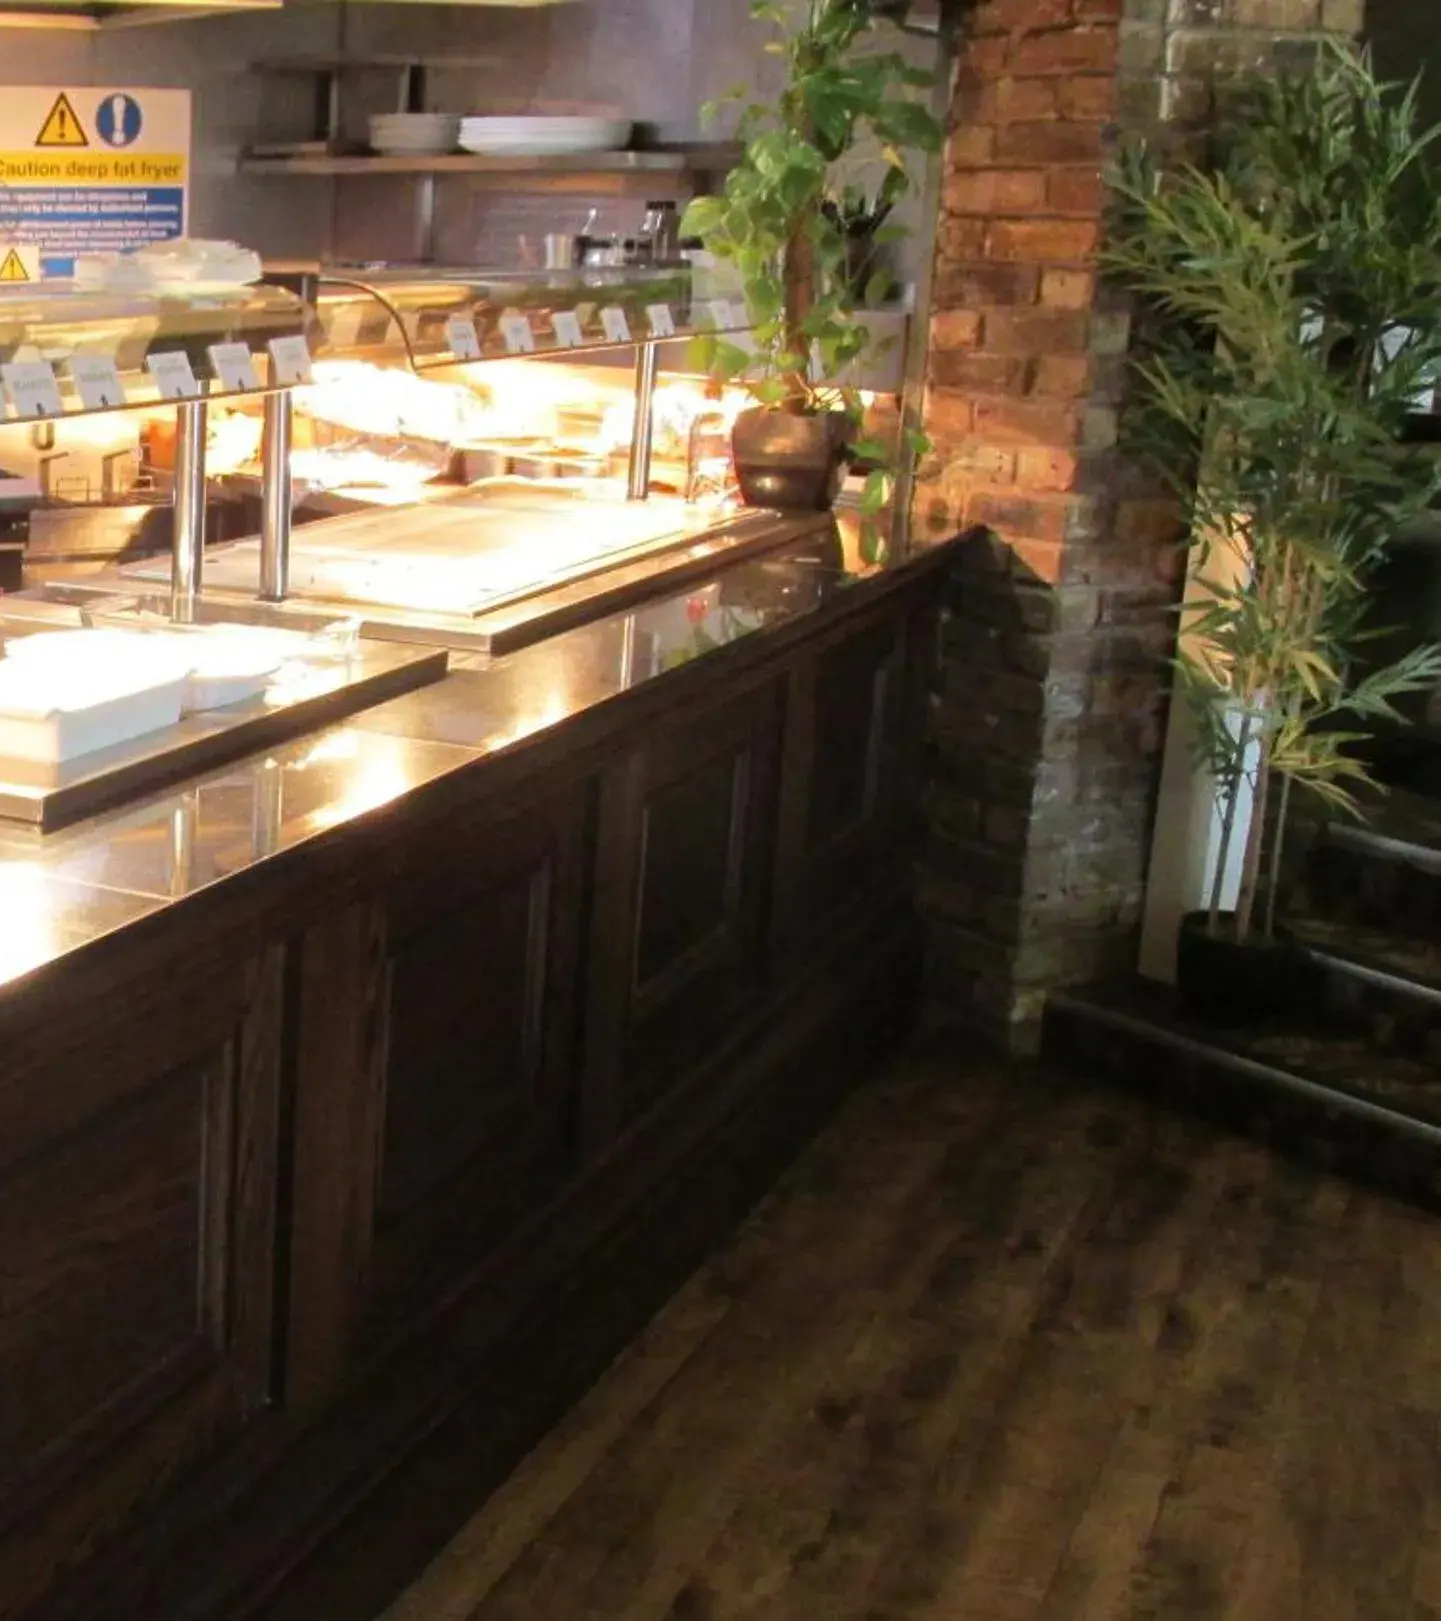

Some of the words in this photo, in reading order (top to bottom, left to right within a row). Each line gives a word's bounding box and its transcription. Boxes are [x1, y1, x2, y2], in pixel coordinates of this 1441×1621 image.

[66, 160, 108, 181] deep
[114, 160, 136, 178] fat
[142, 160, 180, 181] fryer
